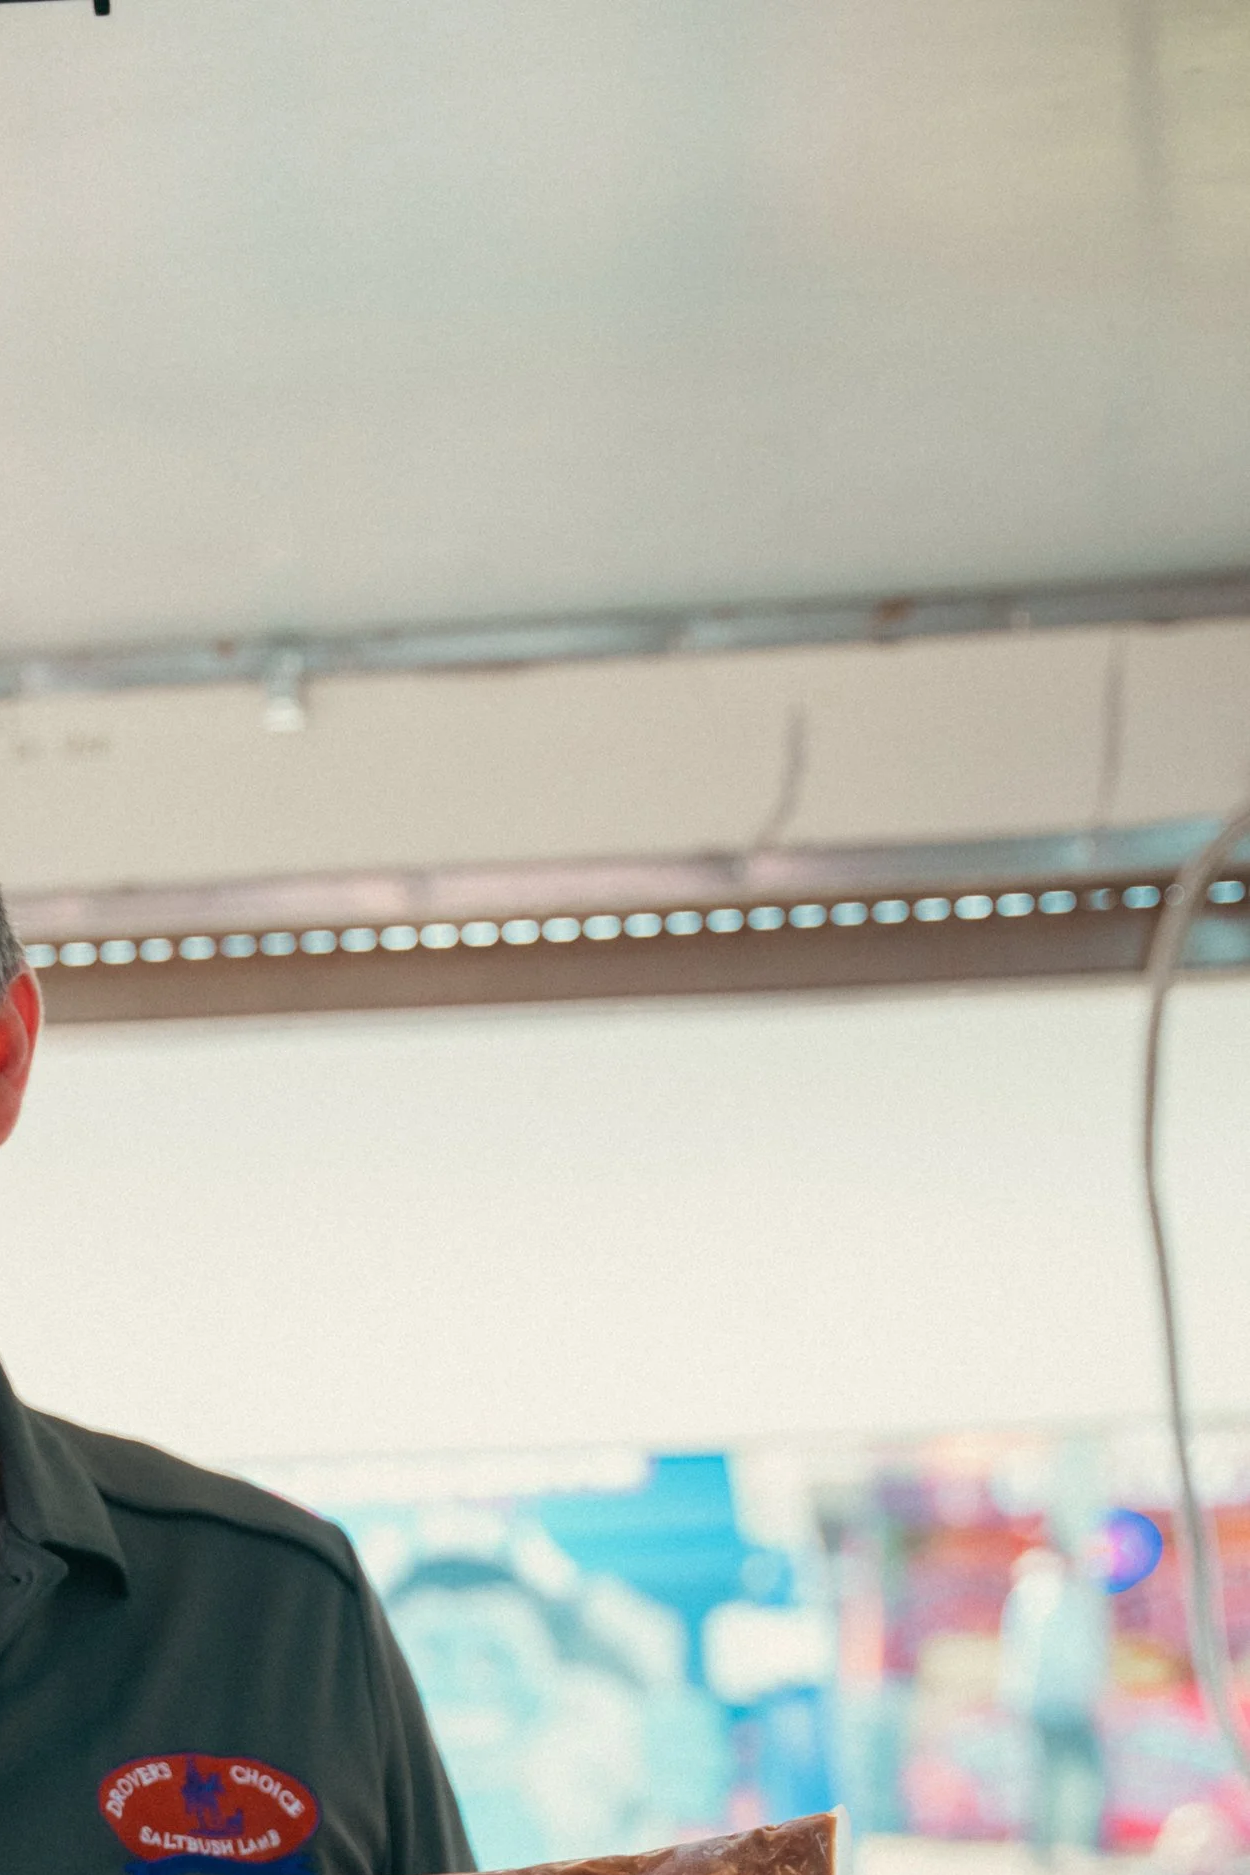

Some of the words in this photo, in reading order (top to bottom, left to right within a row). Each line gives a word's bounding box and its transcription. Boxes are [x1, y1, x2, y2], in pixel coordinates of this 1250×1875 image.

[229, 1764, 306, 1819] CHOICE
[138, 1825, 235, 1856] SALTBUSH
[237, 1828, 282, 1856] LAMB
